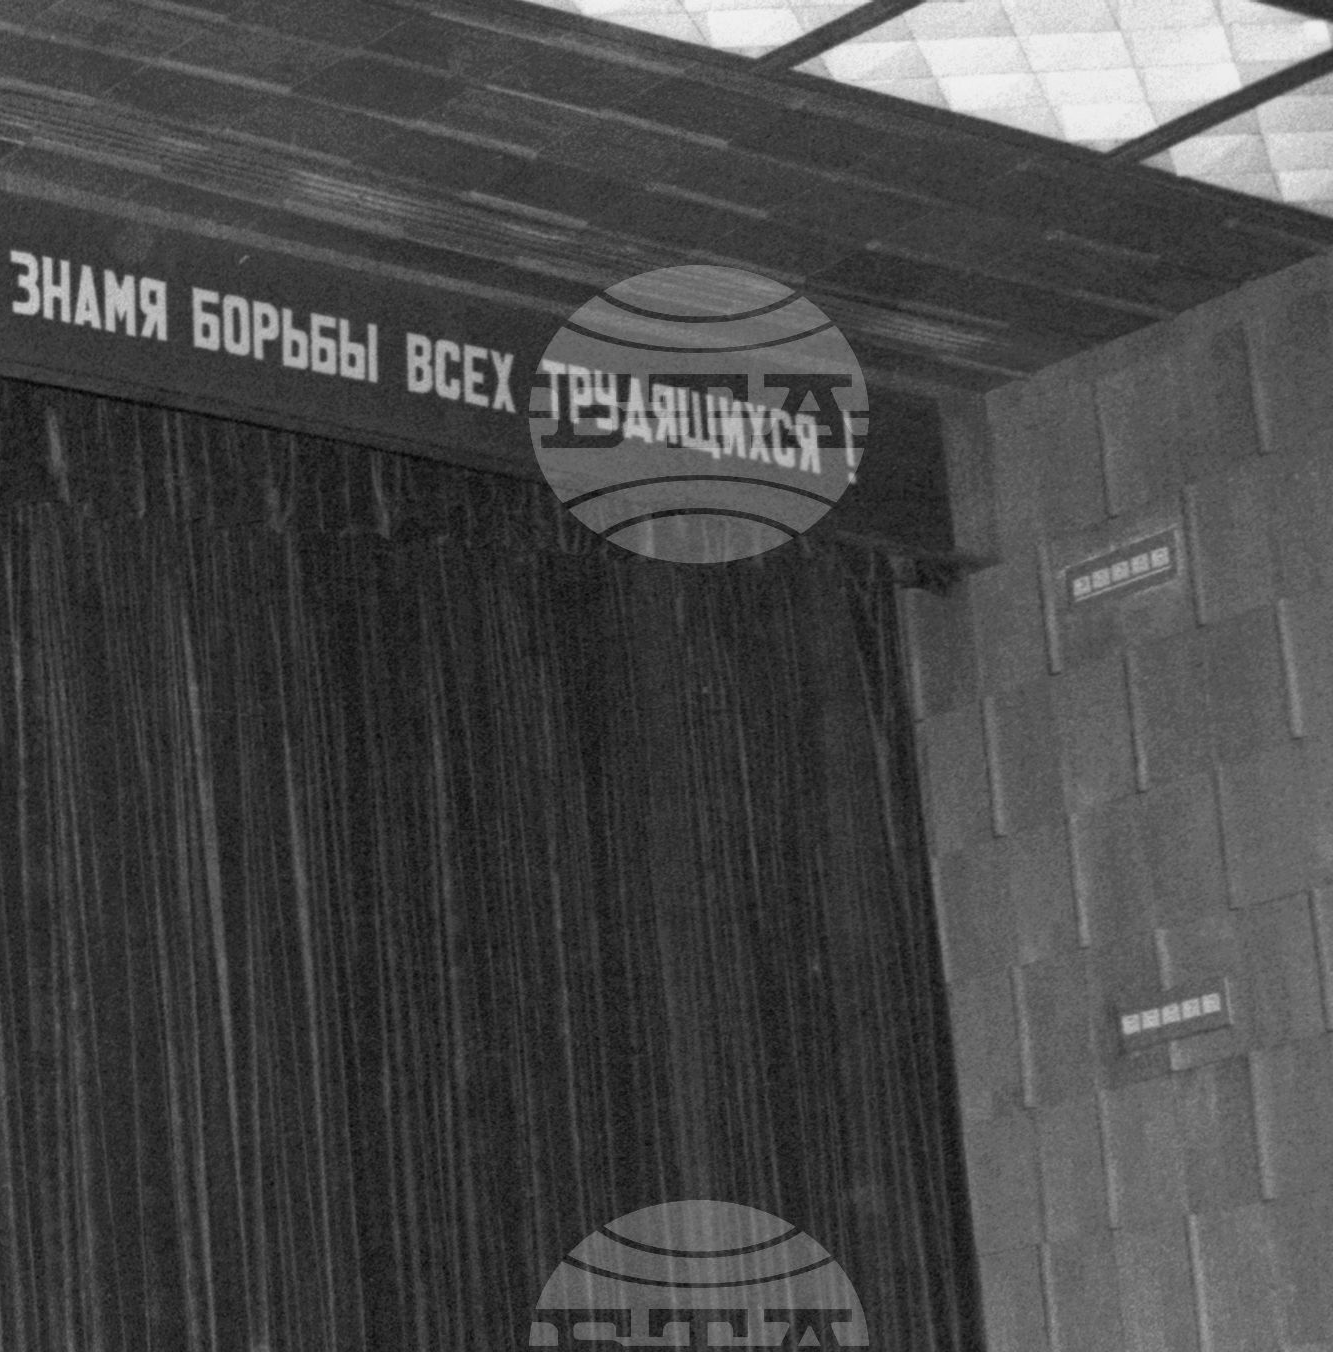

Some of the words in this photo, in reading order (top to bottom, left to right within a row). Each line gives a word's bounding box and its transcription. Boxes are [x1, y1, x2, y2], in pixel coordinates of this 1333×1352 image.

[10, 250, 168, 341] ЗНАМЯ
[192, 287, 379, 383] БОРЬБЫ
[406, 333, 516, 413] ВСЕХ
